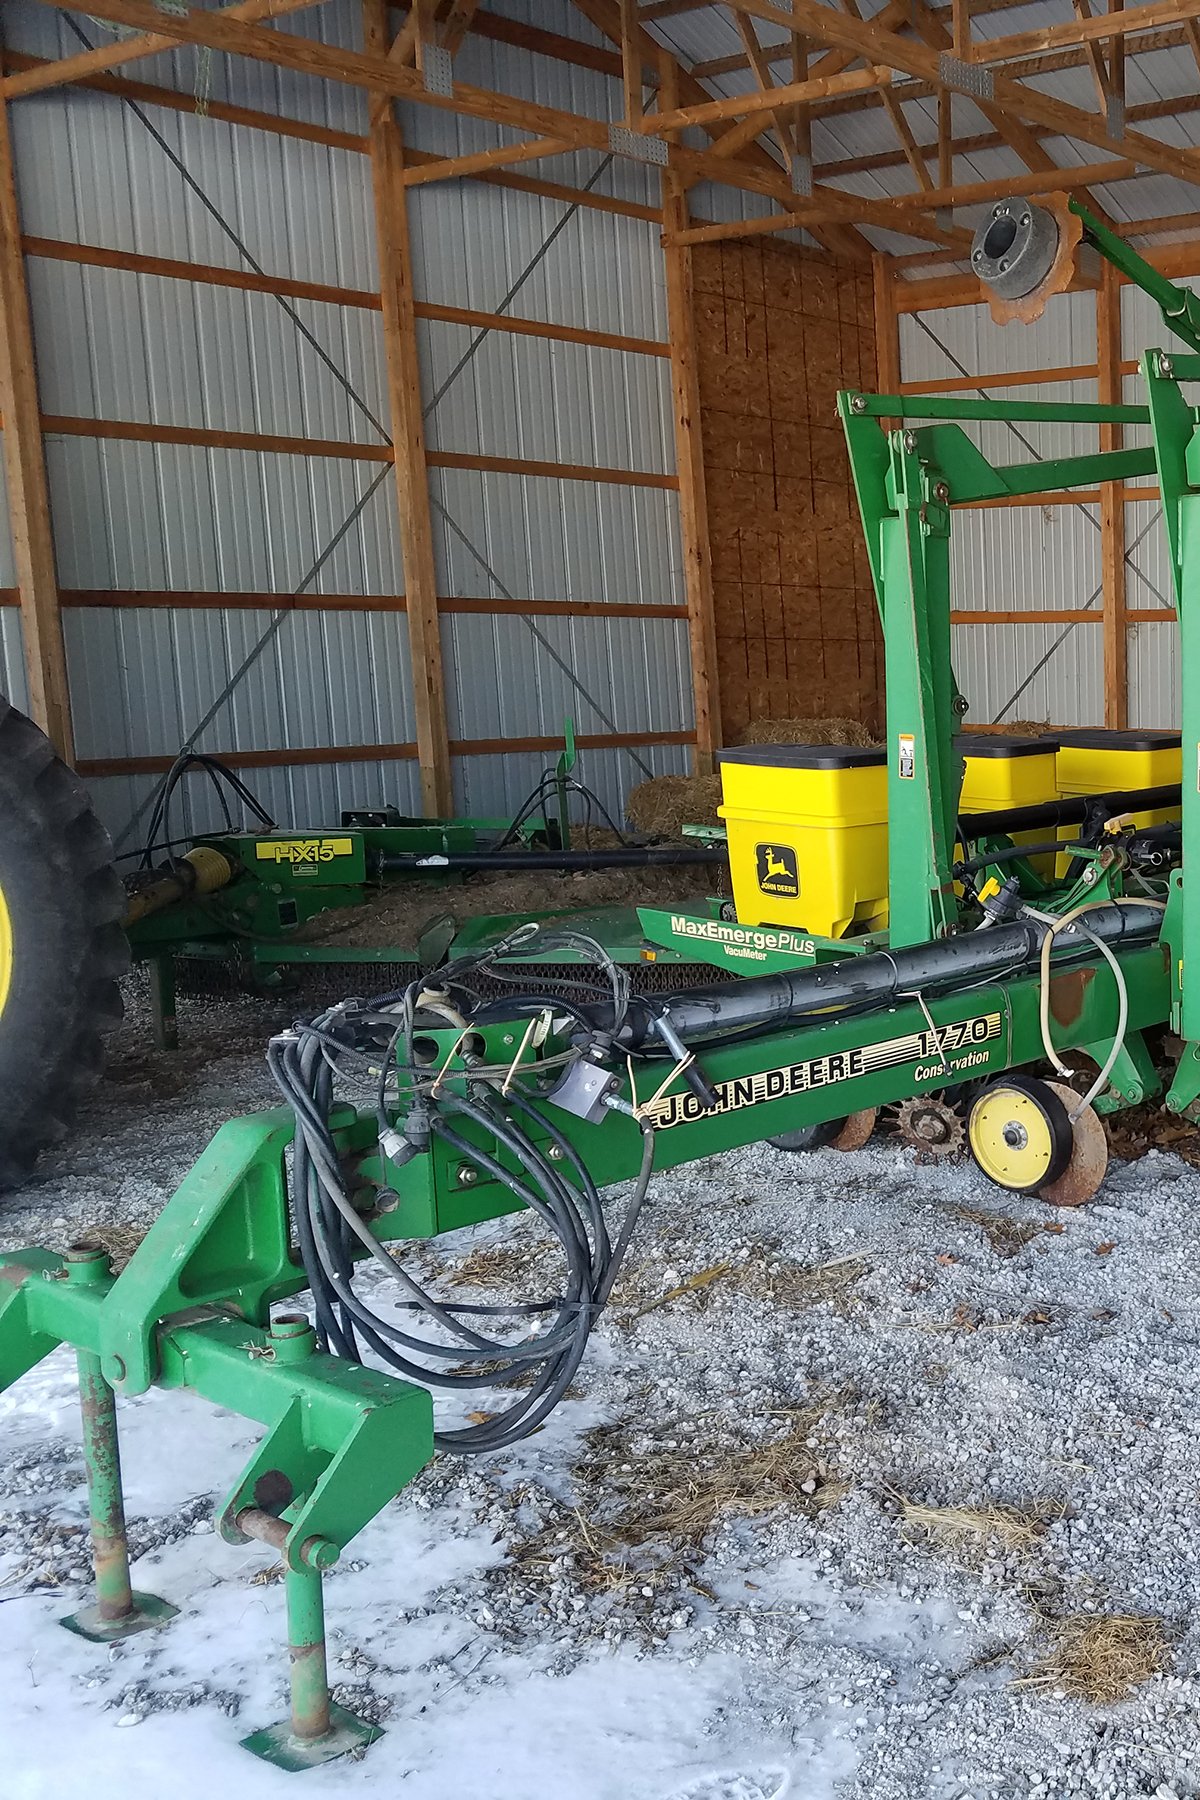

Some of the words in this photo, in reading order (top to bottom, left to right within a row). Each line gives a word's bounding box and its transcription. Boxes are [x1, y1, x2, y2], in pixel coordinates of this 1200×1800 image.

[275, 844, 335, 864] HX15
[760, 882, 777, 891] JOHN
[777, 884, 797, 894] DEERE
[723, 944, 768, 961] VacuMeter
[766, 1050, 863, 1098] DEERE
[918, 1018, 988, 1056] 1770
[914, 1050, 990, 1082] Consrvation
